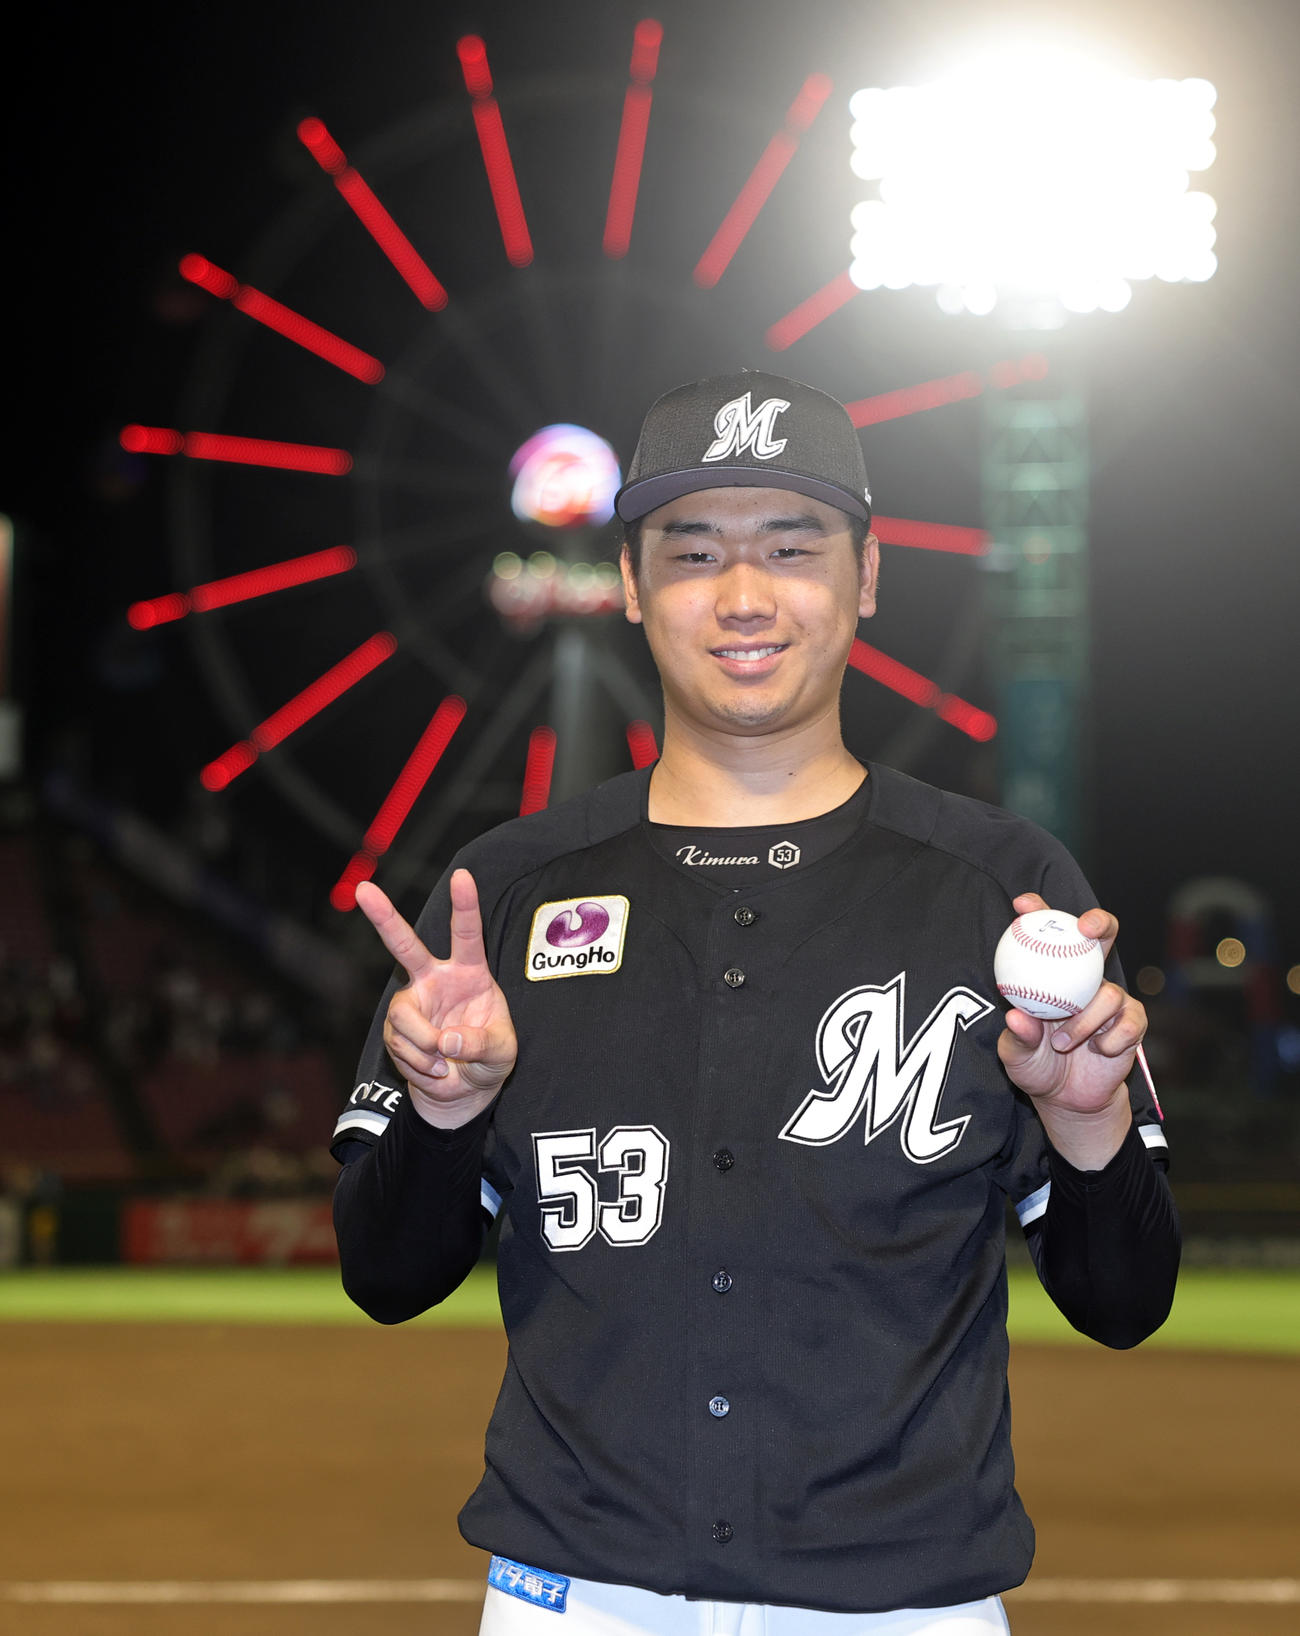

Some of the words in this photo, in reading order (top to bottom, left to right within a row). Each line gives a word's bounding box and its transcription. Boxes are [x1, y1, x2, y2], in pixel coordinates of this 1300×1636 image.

[702, 391, 792, 463] M
[675, 845, 761, 866] Kimura
[776, 849, 793, 862] 53
[532, 946, 616, 971] GungHo
[778, 971, 996, 1165] M
[531, 1124, 671, 1252] 53
